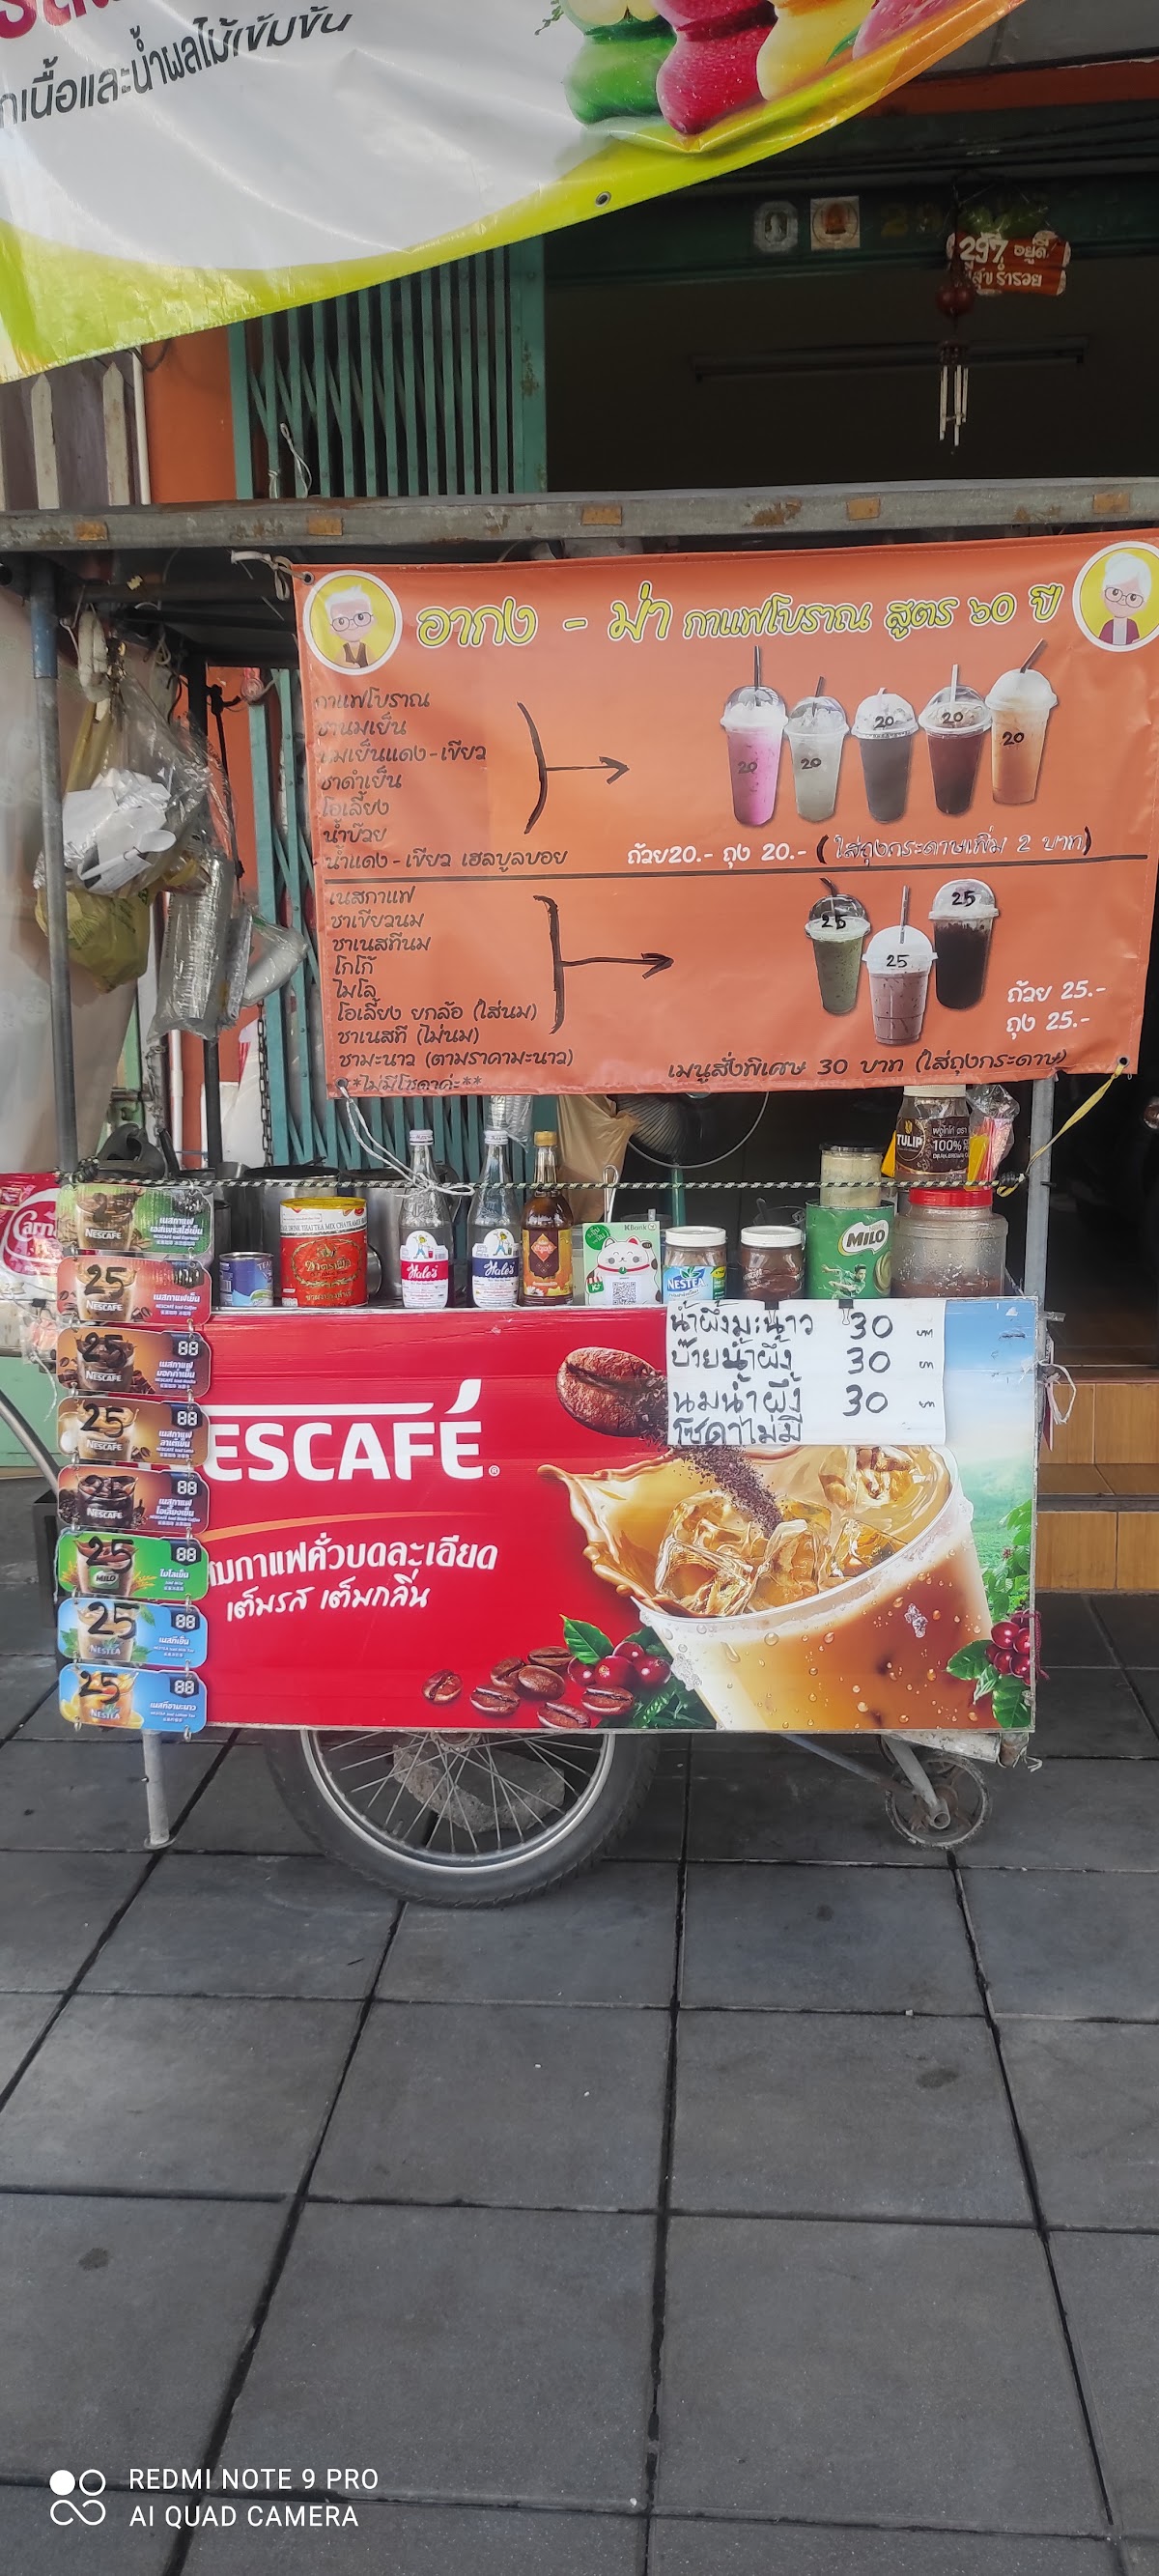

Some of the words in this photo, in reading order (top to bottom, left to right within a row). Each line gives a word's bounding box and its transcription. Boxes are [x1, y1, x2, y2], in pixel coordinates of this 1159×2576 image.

[959, 236, 1008, 263] 297
[416, 596, 538, 648] อากง
[608, 581, 673, 641] ม่า
[683, 592, 872, 638] กาแฟโบราณ
[885, 598, 959, 640] สูตร
[1029, 582, 1064, 624] ปี
[316, 687, 430, 709] กาแฟโบราณ
[873, 715, 894, 729] 20
[942, 712, 964, 724] 20
[1002, 731, 1025, 746] 20
[737, 761, 758, 773] 20
[801, 757, 821, 770] 20
[321, 770, 402, 790] ชาดำเย็น
[723, 842, 750, 868] ถุง
[1017, 835, 1032, 852] 2
[329, 886, 415, 905] เนสกาแฟ
[951, 891, 975, 906] 25
[330, 909, 424, 928] ชาเขียวนม
[332, 932, 431, 951] ชาเนสทีนม
[335, 955, 377, 975] โกโก้
[886, 954, 909, 968] 25
[332, 978, 376, 998] ไมโล
[1006, 980, 1052, 1004] ถ้วย
[337, 998, 401, 1022] โอเลี้ยง
[411, 1002, 463, 1020] ยกล้อ
[338, 1026, 407, 1044] ชาเนสที
[417, 1024, 480, 1045] (ไม่นม)
[1005, 1014, 1035, 1039] ถุง
[339, 1052, 415, 1067] ชามะนาว
[667, 1052, 806, 1083] เมนูสั่งพิเศษ
[817, 1058, 847, 1075] 30
[862, 1058, 904, 1074] บาท
[897, 1134, 922, 1147] TULIP
[933, 1140, 962, 1151] 100%
[14, 1210, 58, 1241] Carn
[846, 1230, 886, 1247] MILO
[84, 1264, 127, 1300] 25
[666, 1277, 706, 1291] NESTEA
[850, 1312, 892, 1340] 30
[847, 1347, 890, 1374] 30
[843, 1384, 889, 1416] 30
[80, 1403, 124, 1438] 25
[203, 1378, 484, 1482] ESCAFÉ
[86, 1536, 133, 1573] 25
[96, 1573, 116, 1582] MILO
[227, 1585, 316, 1623] เต็มรส
[321, 1569, 431, 1610] เต็มกลิ่น
[88, 1601, 140, 1639] 25
[90, 1645, 120, 1655] NESTEA
[79, 1670, 120, 1705] 25
[90, 1709, 120, 1719] NESTEA
